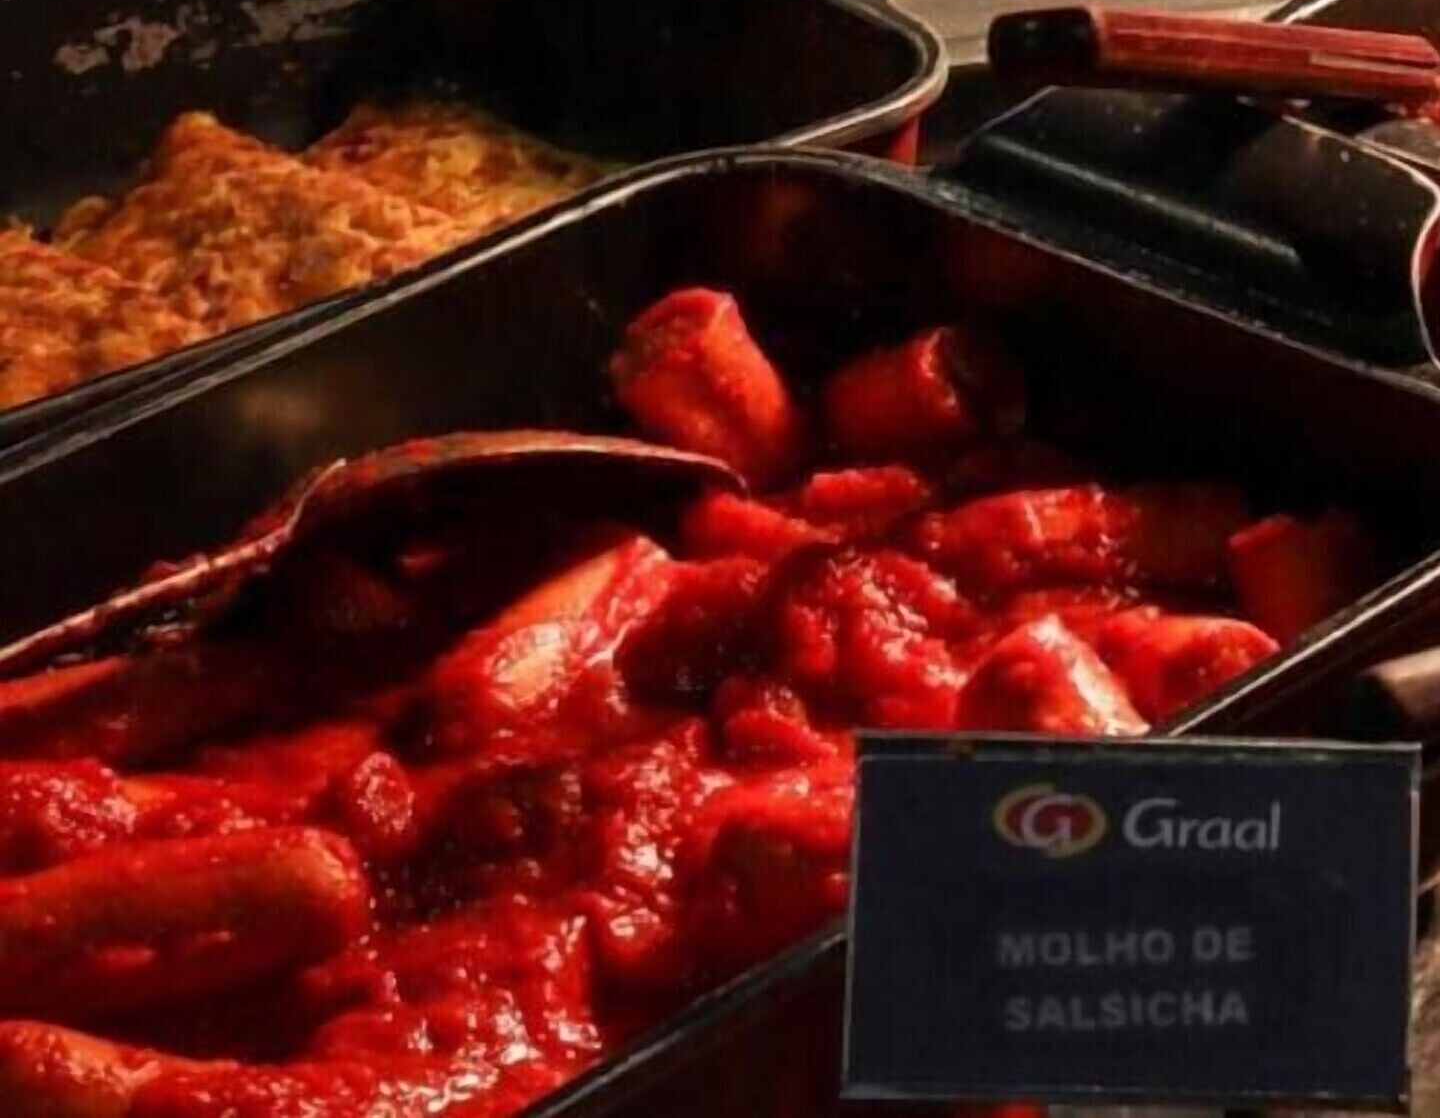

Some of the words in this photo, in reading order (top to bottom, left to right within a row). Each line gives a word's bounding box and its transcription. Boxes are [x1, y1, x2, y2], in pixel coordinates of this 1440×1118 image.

[1122, 797, 1281, 851] Graal
[1000, 929, 1174, 966] MOLHO
[1193, 926, 1255, 962] DE
[1005, 991, 1249, 1031] SALSICHA
